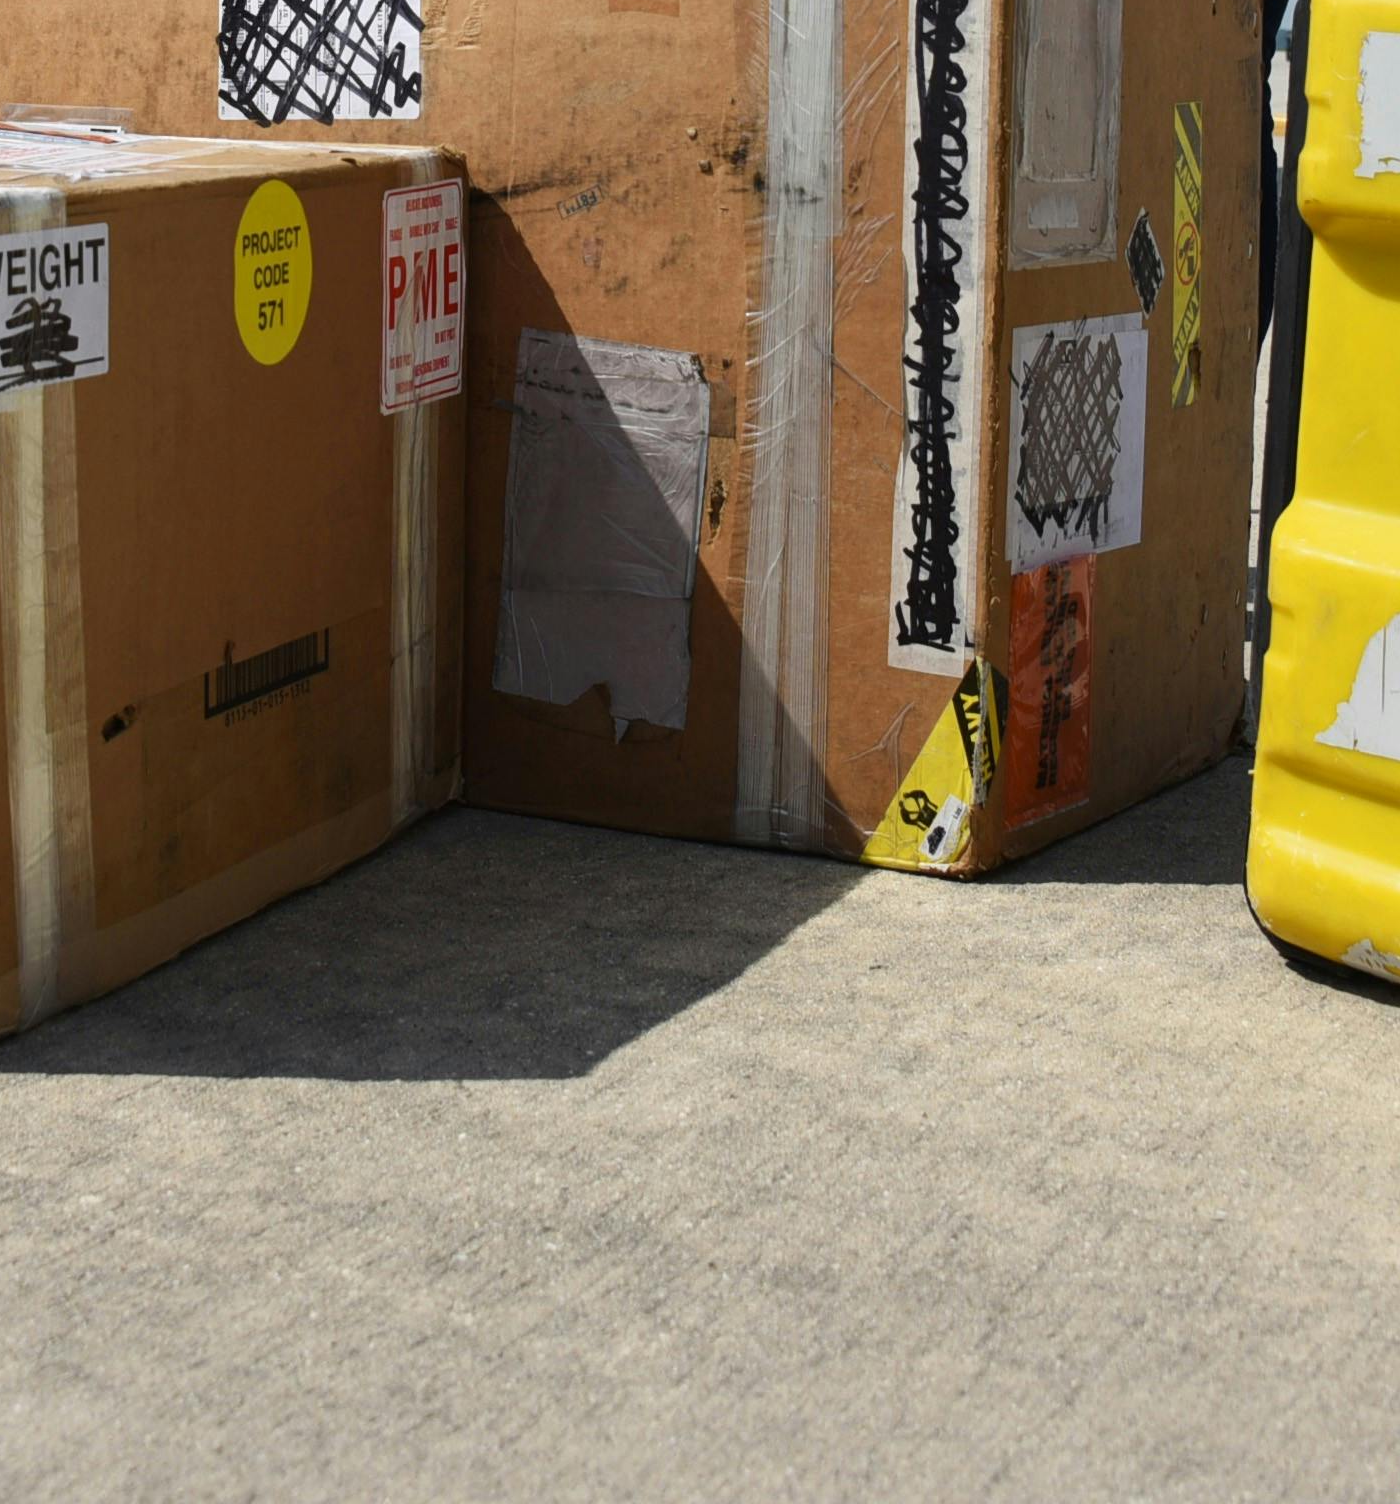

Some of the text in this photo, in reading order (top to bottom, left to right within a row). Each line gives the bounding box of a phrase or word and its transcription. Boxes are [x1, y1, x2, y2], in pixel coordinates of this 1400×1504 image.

[241, 225, 302, 257] PROJECT
[253, 262, 290, 290] CODE
[388, 242, 460, 330] PME
[257, 299, 285, 331] 571
